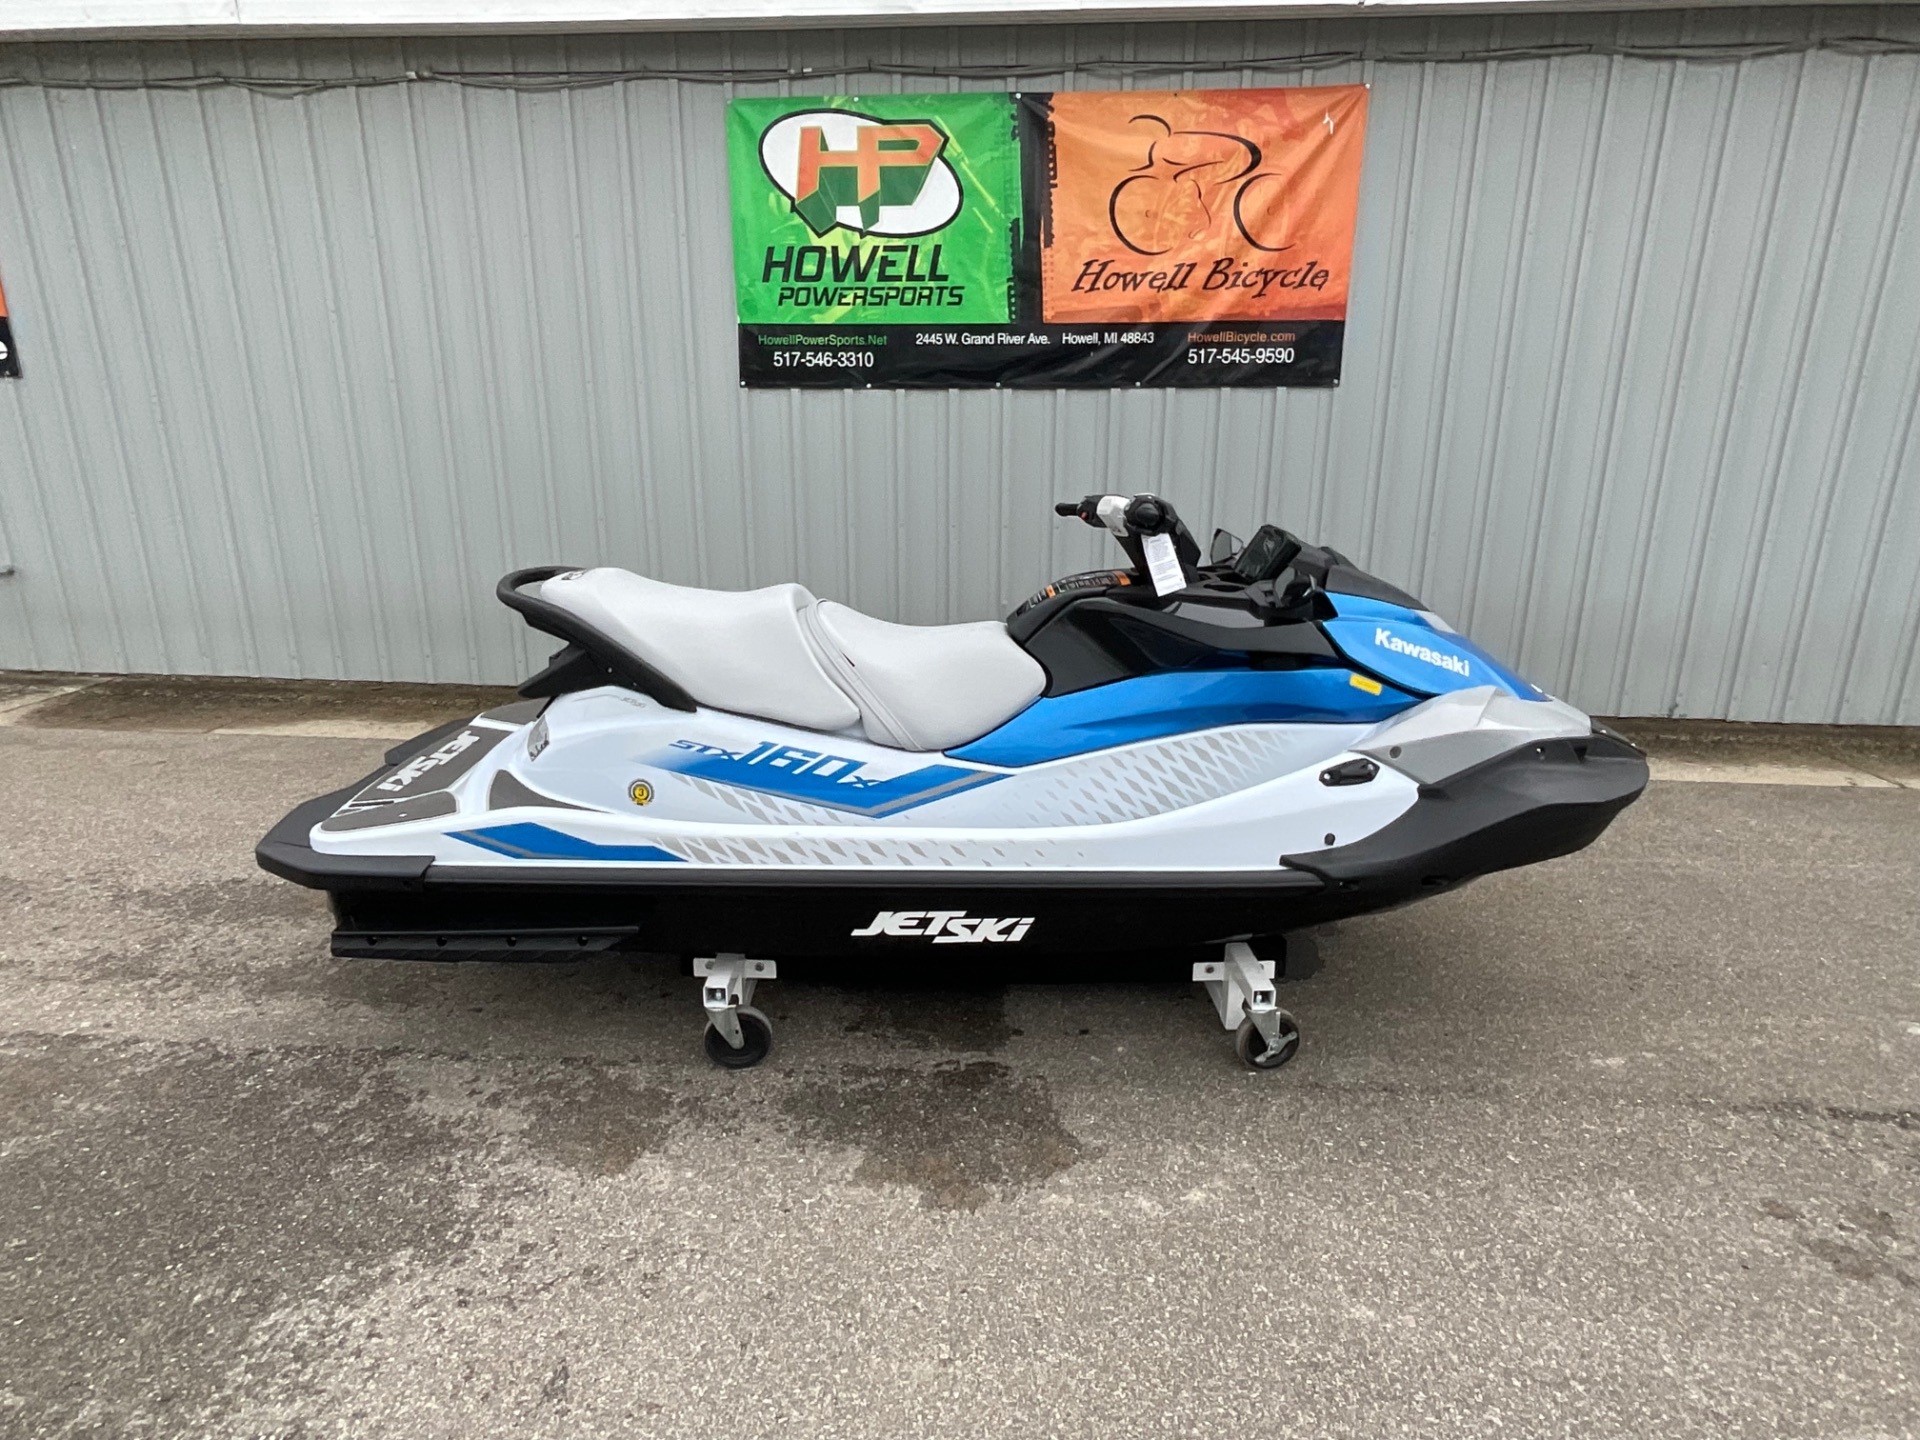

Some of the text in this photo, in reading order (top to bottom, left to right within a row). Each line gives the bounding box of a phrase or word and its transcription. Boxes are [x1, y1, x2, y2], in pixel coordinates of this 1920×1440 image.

[796, 124, 944, 204] HP
[762, 244, 949, 283] HOWELL
[1071, 257, 1330, 299] Howell Bicycle
[778, 286, 965, 307] POWERSPORTS
[758, 333, 888, 348] HowellPowerSports.Net
[915, 331, 1155, 345] 2445 W. Grand River Ave. Howell, MI 48843
[1187, 330, 1296, 344] HowellBicycle.com
[773, 351, 874, 367] 517-546-3310
[1187, 347, 1295, 364] 517-545-9590
[1375, 627, 1470, 677] Kawasaki
